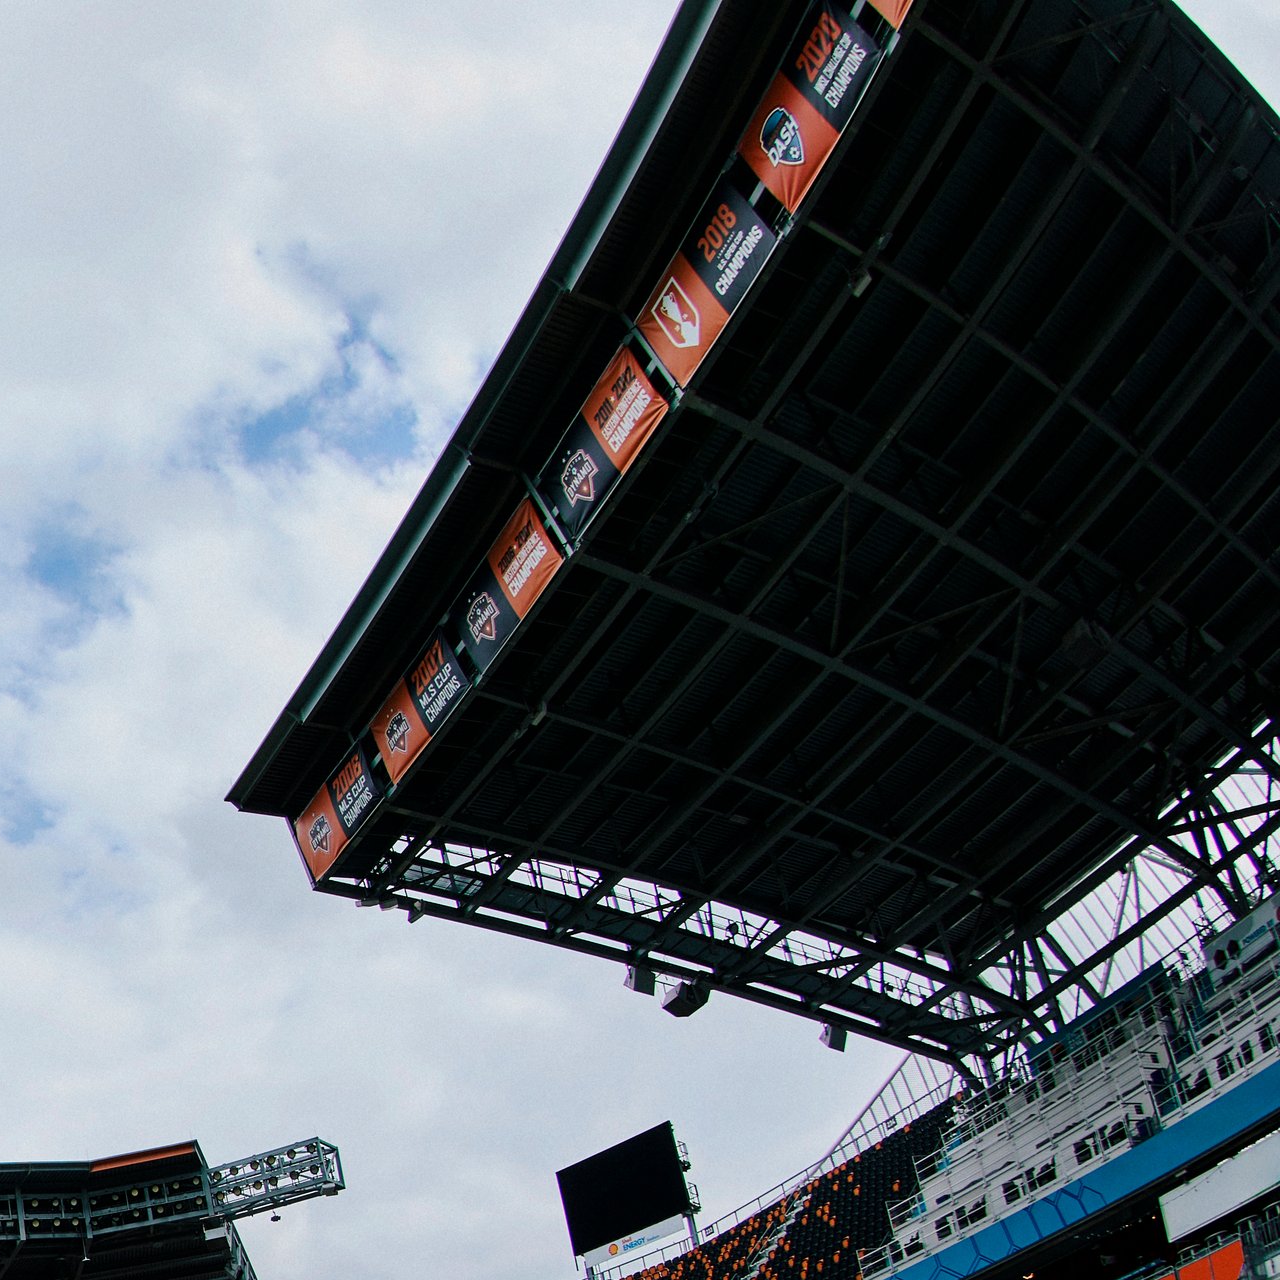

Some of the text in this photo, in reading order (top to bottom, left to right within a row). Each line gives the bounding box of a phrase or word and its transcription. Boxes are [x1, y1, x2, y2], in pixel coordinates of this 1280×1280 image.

[795, 11, 842, 83] 2020
[823, 45, 845, 80] CHALLENGE
[839, 32, 853, 49] CUP
[824, 43, 867, 109] CHAMPIONS
[767, 114, 799, 168] DASH
[697, 203, 737, 263] 2018
[723, 242, 737, 260] OPEN
[733, 230, 743, 243] CUP
[715, 224, 763, 296] CHAMPIONS
[594, 397, 614, 430] 2011
[607, 390, 651, 454] CHAMPIONS
[615, 378, 642, 418] CONFERENCE
[566, 460, 593, 498] DYNAMO
[507, 539, 548, 598] CHAMPIONS
[472, 603, 495, 637] DYNAMO
[411, 639, 445, 697] 2007
[418, 662, 452, 709] MLS CUP
[424, 675, 461, 723] CHAMPIONS
[338, 774, 366, 815] MLS CUP
[343, 786, 373, 828] CHAMPIONS
[622, 1236, 646, 1251] ENERGY
